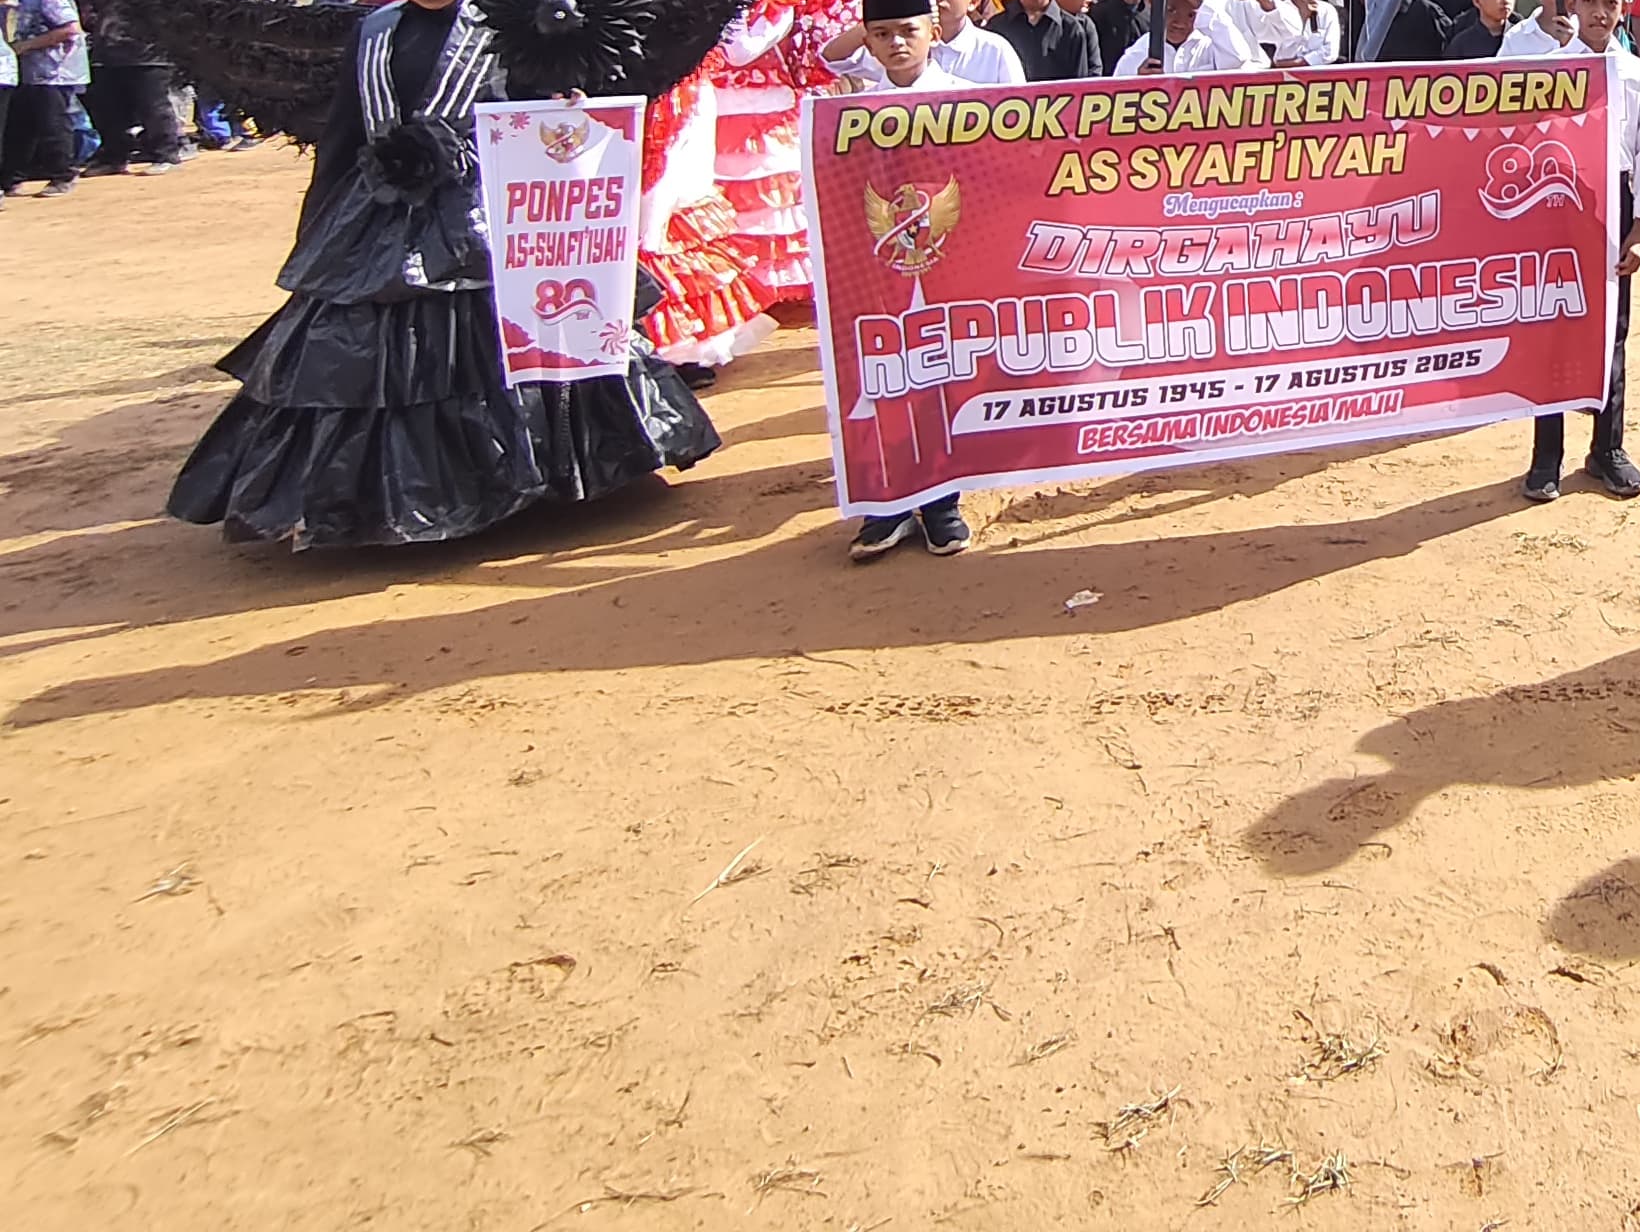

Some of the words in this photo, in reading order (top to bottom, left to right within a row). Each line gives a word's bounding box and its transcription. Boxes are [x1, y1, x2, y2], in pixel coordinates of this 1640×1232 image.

[836, 95, 1073, 154] PONDOK
[1077, 79, 1369, 137] PESANTREN
[1384, 70, 1588, 119] MODERN
[506, 176, 625, 224] PONPES
[1047, 150, 1121, 196] AS
[1017, 188, 1442, 277] DIRGAHAYU
[855, 281, 1217, 400] REPUBLIK
[1223, 248, 1588, 356] INDONESIA
[983, 399, 1011, 421] 17
[1019, 387, 1148, 418] AGUSTUS
[1159, 379, 1226, 405] 1945
[1255, 373, 1279, 395] 17
[1287, 358, 1408, 390] AGUSTUS
[1415, 349, 1483, 374] 2025
[1078, 415, 1197, 455] BERSAMA
[1202, 398, 1334, 441] INDONESIA
[1334, 389, 1404, 425] MAJU
